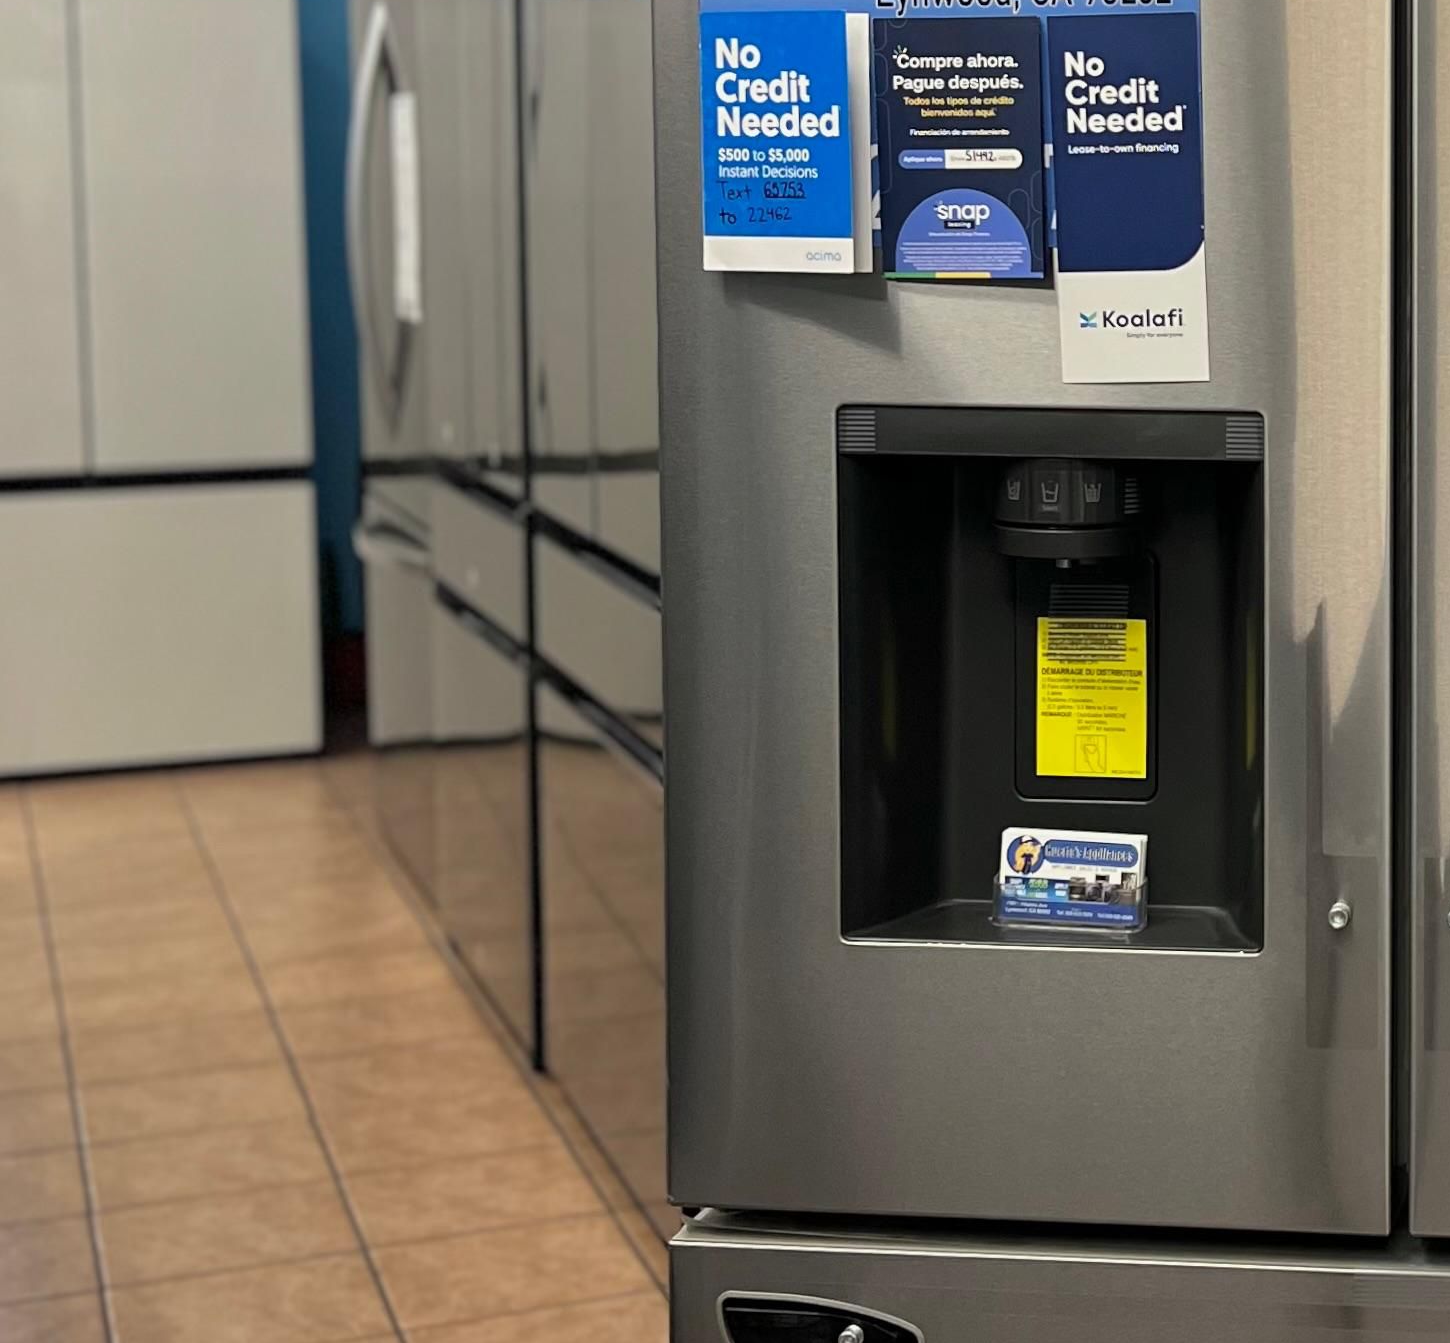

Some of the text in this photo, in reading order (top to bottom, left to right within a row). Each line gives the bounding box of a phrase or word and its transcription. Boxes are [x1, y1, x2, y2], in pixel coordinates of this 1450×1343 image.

[715, 38, 761, 69] No
[897, 53, 1018, 71] Compre ahora.
[1064, 51, 1104, 77] No
[715, 71, 811, 104] Credit
[892, 74, 1024, 93] Pague después.
[1065, 77, 1160, 107] Credit
[904, 96, 930, 106] Todos
[932, 96, 945, 105] los
[946, 96, 968, 107] tipos
[970, 96, 982, 105] de
[717, 105, 841, 138] Needed
[921, 108, 974, 118] bienvenidos
[718, 148, 810, 164] $500 to $5,000
[1068, 142, 1179, 155] Lease-to-own financing
[719, 165, 819, 178] Instant Decisions
[716, 180, 752, 200] Text
[719, 207, 737, 225] to
[937, 204, 990, 226] snap
[806, 251, 842, 262] acima
[1102, 308, 1184, 328] Koalafi
